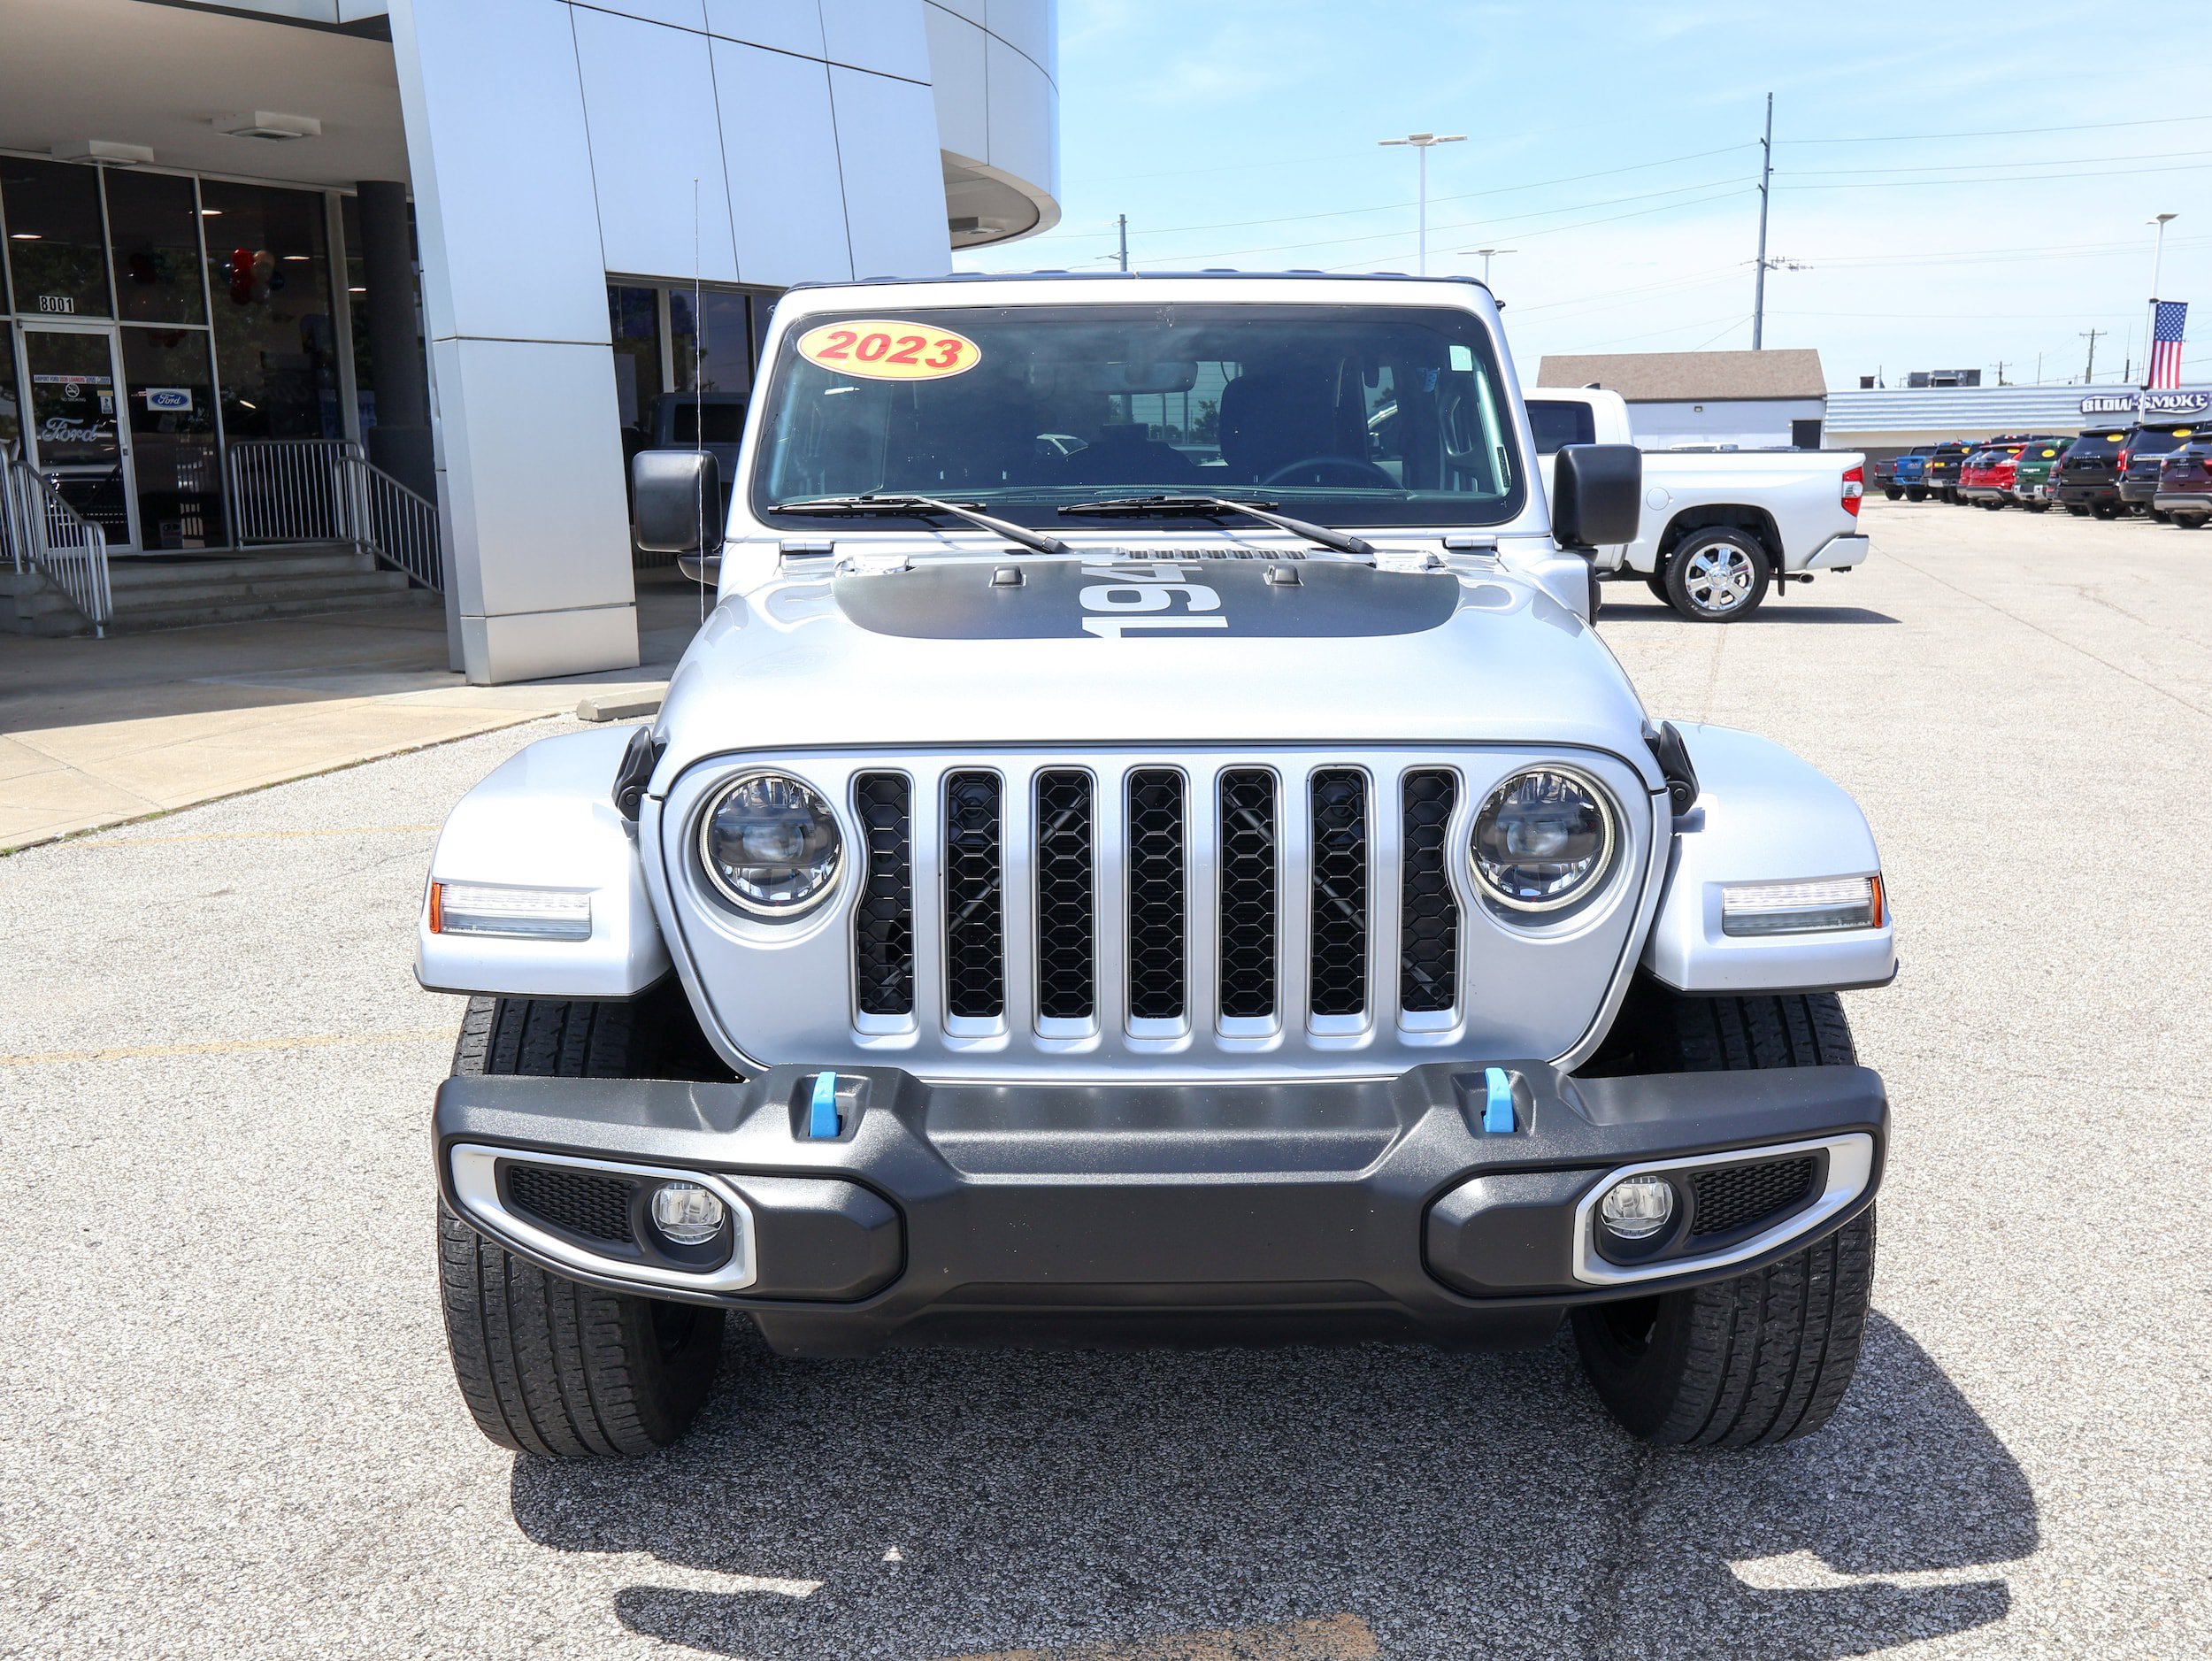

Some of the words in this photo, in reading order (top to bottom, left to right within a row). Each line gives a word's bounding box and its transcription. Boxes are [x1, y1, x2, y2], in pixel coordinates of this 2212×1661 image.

[41, 296, 73, 312] 8001
[816, 331, 964, 369] 2023
[157, 393, 181, 405] Ford
[2082, 396, 2131, 412] BLOW
[2138, 394, 2208, 411] SMOKE
[41, 417, 98, 442] Ford
